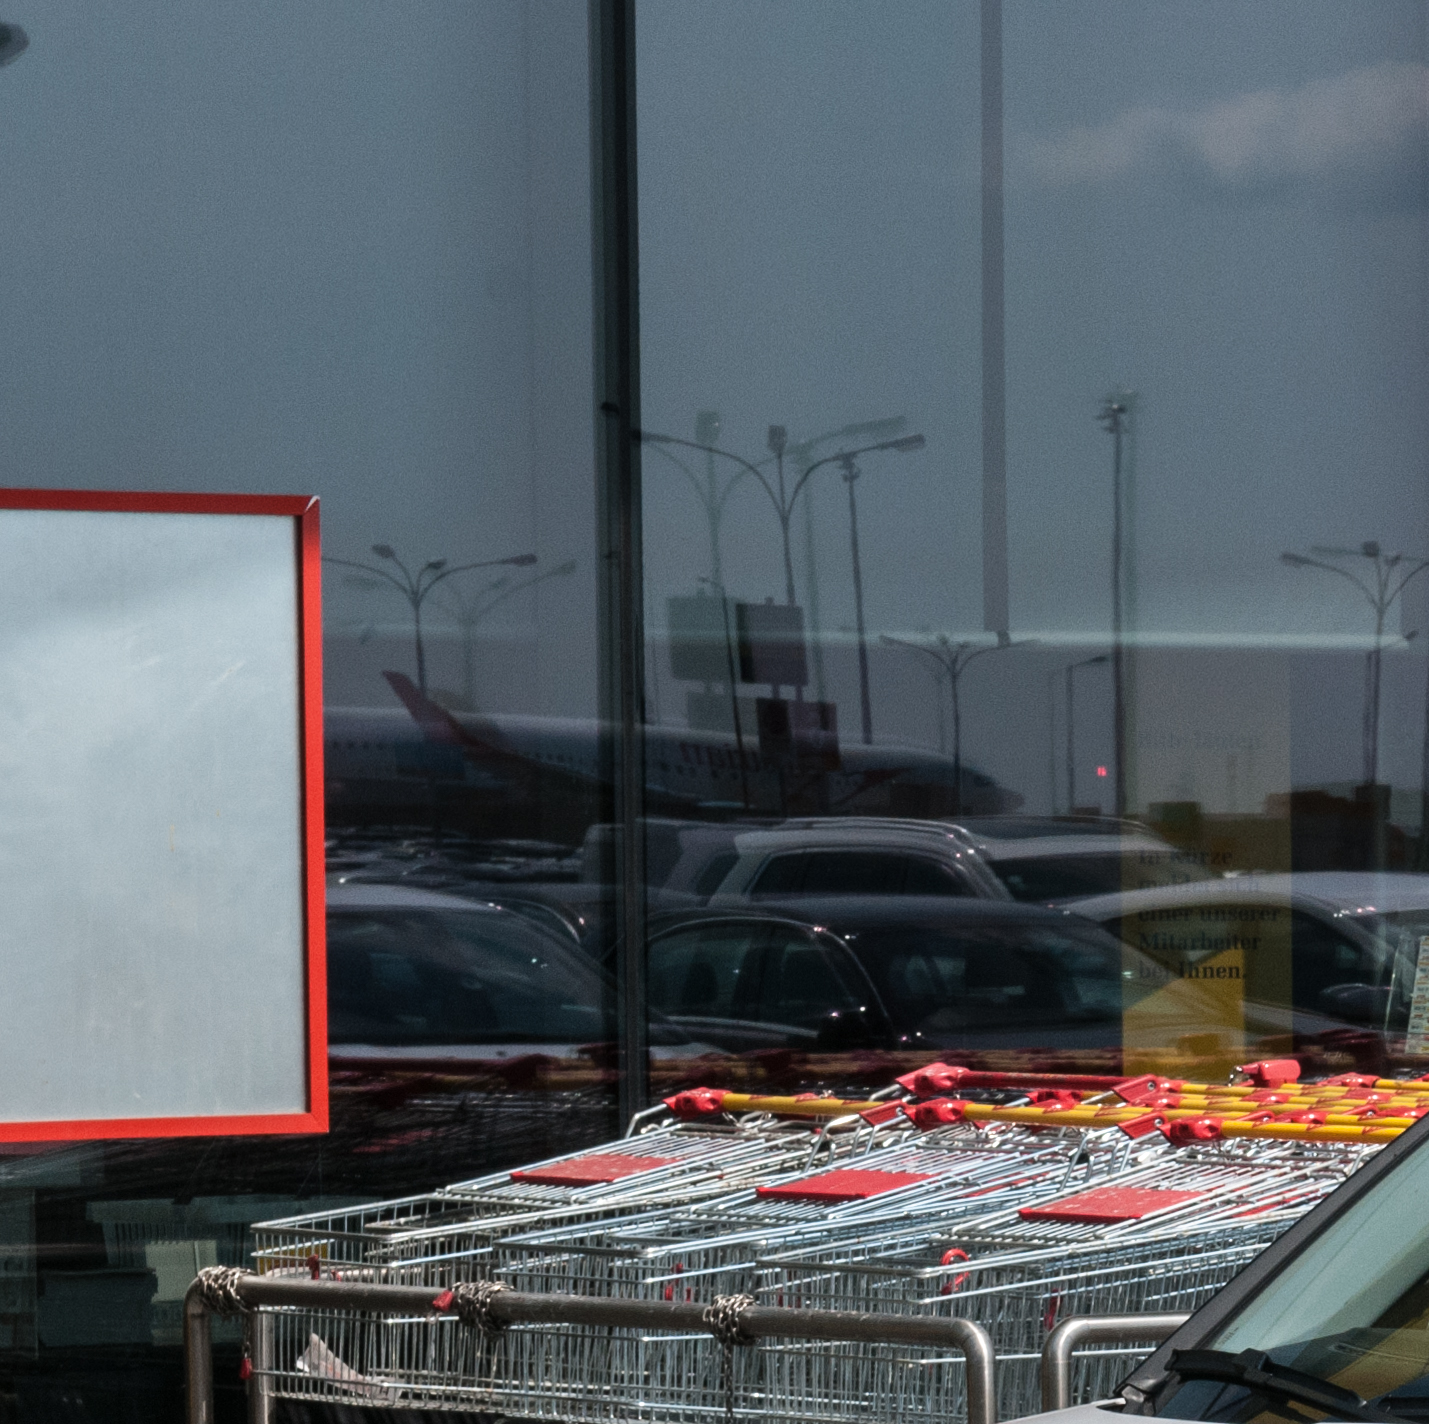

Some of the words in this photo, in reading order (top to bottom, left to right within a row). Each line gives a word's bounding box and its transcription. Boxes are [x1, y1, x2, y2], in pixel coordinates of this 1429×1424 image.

[1200, 907, 1280, 921] unserer
[1138, 932, 1262, 951] Mitarbeiter
[1139, 960, 1170, 979] bei
[1178, 960, 1247, 979] Ihnen.
